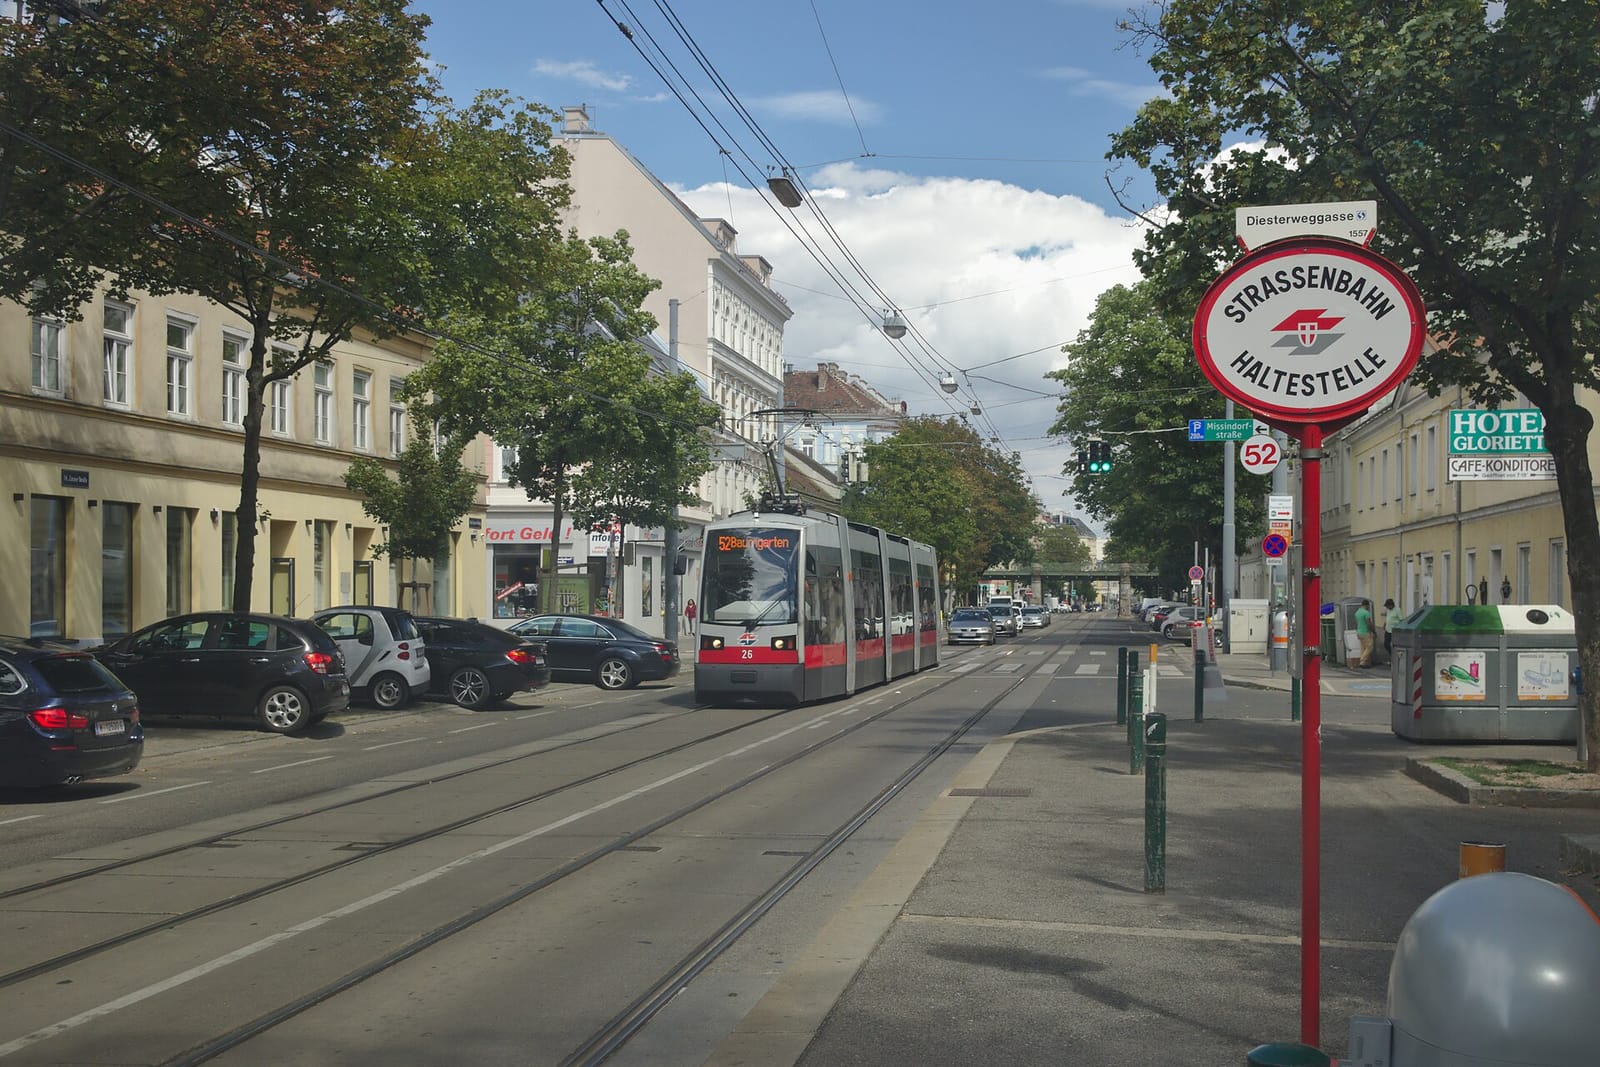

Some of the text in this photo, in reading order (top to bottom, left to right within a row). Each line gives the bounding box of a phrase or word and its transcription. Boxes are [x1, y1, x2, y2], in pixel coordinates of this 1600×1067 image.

[1246, 213, 1354, 226] Diesterweggasse
[1348, 229, 1368, 238] 1557
[1224, 265, 1395, 324] STRASSENBAHN
[1230, 346, 1387, 397] HALTESTELLE
[1206, 421, 1252, 431] Missindorf-
[1215, 431, 1243, 440] straße
[1245, 442, 1278, 467] 52
[719, 535, 790, 551] 52 Baumgarten
[741, 649, 754, 660] 26
